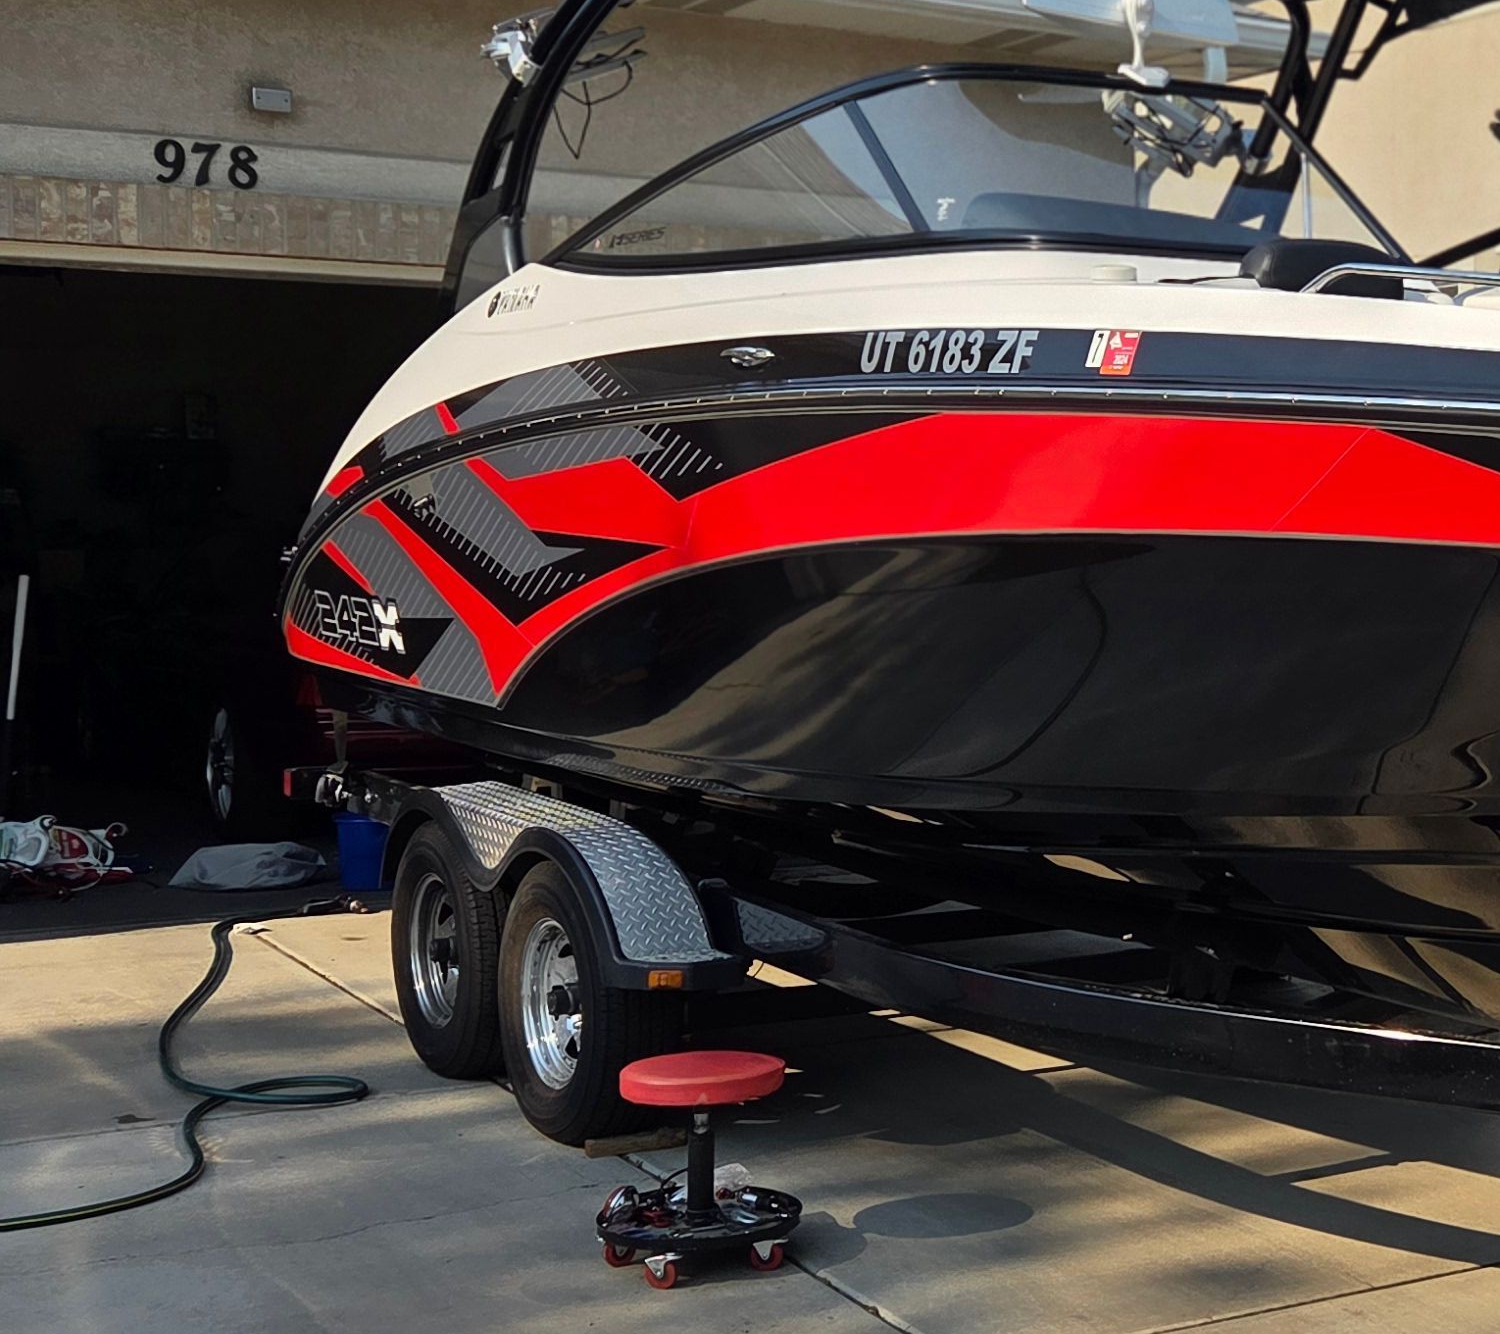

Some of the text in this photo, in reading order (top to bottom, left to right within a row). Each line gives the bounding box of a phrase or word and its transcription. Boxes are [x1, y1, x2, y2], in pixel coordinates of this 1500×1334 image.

[153, 138, 258, 190] 978
[860, 329, 1040, 374] UT 6183 ZF
[1091, 333, 1104, 364] 7
[314, 589, 406, 654] 242X
